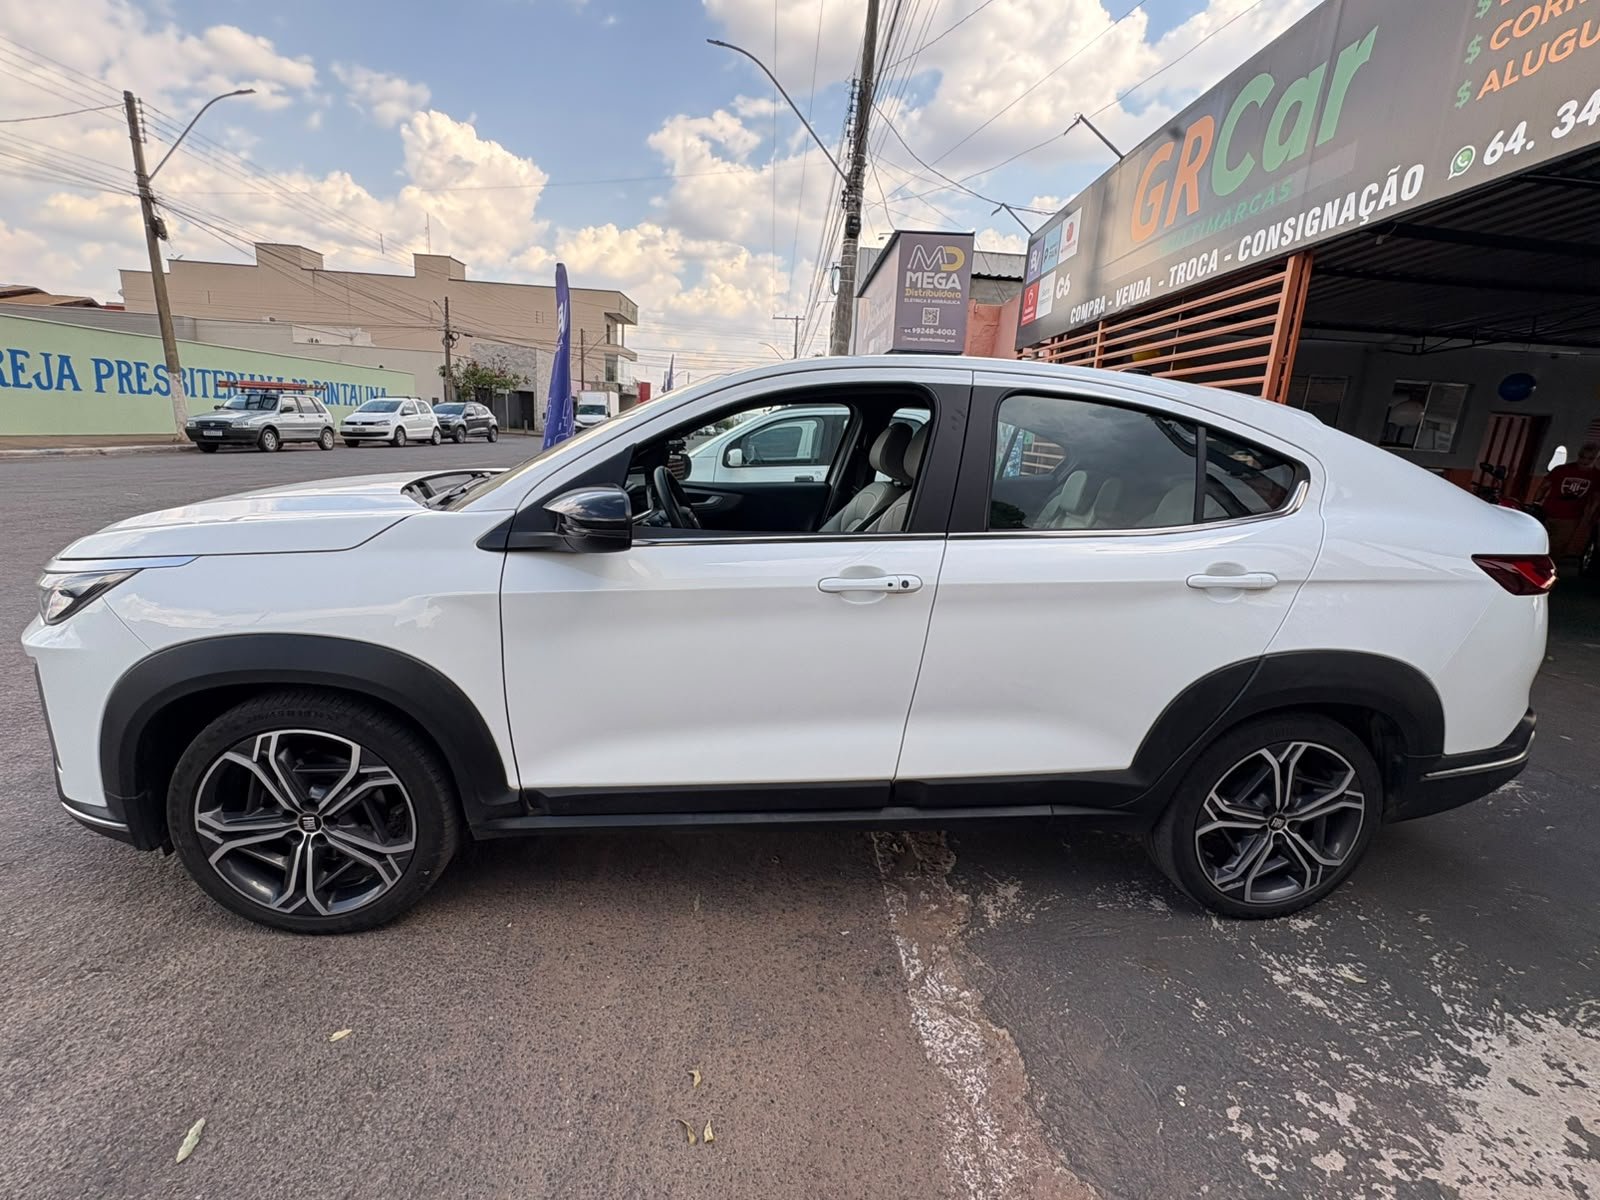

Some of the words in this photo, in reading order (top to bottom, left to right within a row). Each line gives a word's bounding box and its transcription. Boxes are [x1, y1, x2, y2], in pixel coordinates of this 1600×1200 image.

[1475, 19, 1600, 101] ALUGU
[1482, 120, 1535, 165] 64.
[1551, 88, 1600, 139] 34
[1070, 295, 1106, 324] COMPRA
[1115, 276, 1151, 308] VENDA
[1168, 248, 1218, 288] TROCA
[1237, 163, 1425, 263] CONSIGNAÇÃO
[904, 288, 962, 299] Distribuidora
[905, 271, 962, 290] MEGA
[1056, 272, 1071, 300] C6
